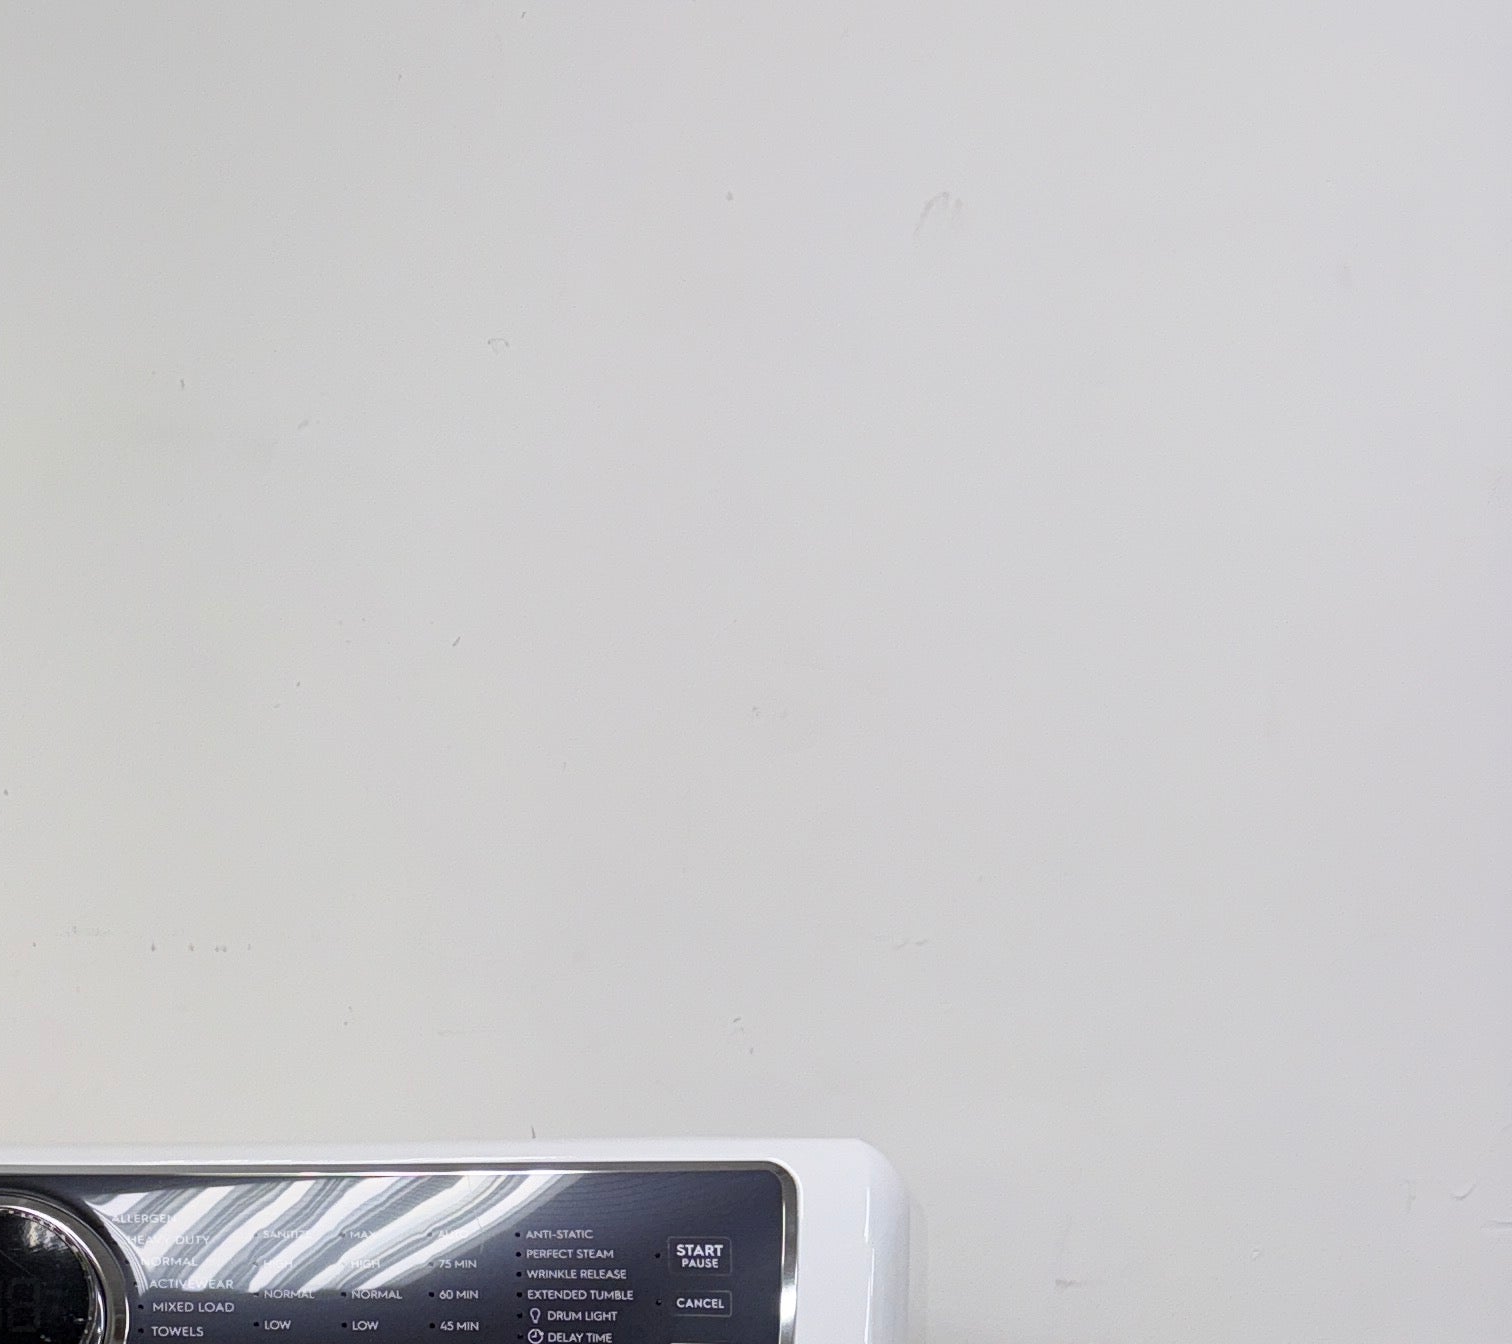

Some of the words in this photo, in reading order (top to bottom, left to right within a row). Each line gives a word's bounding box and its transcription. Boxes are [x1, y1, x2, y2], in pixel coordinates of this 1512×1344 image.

[126, 1235, 171, 1246] HEAY
[176, 1235, 211, 1246] DUTY
[349, 1230, 378, 1240] MAX
[525, 1229, 595, 1241] ANTI-STATIC
[526, 1248, 574, 1260] PERFECT
[576, 1248, 615, 1260] STEAM
[675, 1243, 724, 1258] START
[140, 1256, 199, 1268] NORMAL
[350, 1259, 381, 1270] HIGH
[438, 1259, 453, 1270] 75
[454, 1259, 478, 1270] MIN
[680, 1258, 719, 1269] PAUSE
[526, 1268, 578, 1280] WRINKLE
[580, 1269, 627, 1281] RELEASE
[149, 1278, 235, 1290] ACTIVEWEAR
[263, 1289, 316, 1300] NORMAL
[351, 1289, 404, 1300] NORMAL
[438, 1289, 454, 1300] 60
[456, 1289, 480, 1300] MIN
[527, 1288, 588, 1301] EXTENDED
[589, 1289, 634, 1301] TUMBLE
[152, 1301, 195, 1313] MIXED
[197, 1301, 236, 1314] LOAD
[675, 1297, 726, 1309] CANCEL
[547, 1310, 583, 1322] DRUM
[584, 1310, 619, 1322] LIGHT
[263, 1319, 292, 1331] LOW
[351, 1320, 380, 1331] LOW
[439, 1320, 455, 1332] 45
[456, 1320, 481, 1332] MIN
[151, 1326, 205, 1338] TOWELS
[547, 1332, 584, 1344] DELAY
[585, 1332, 614, 1344] TIME
